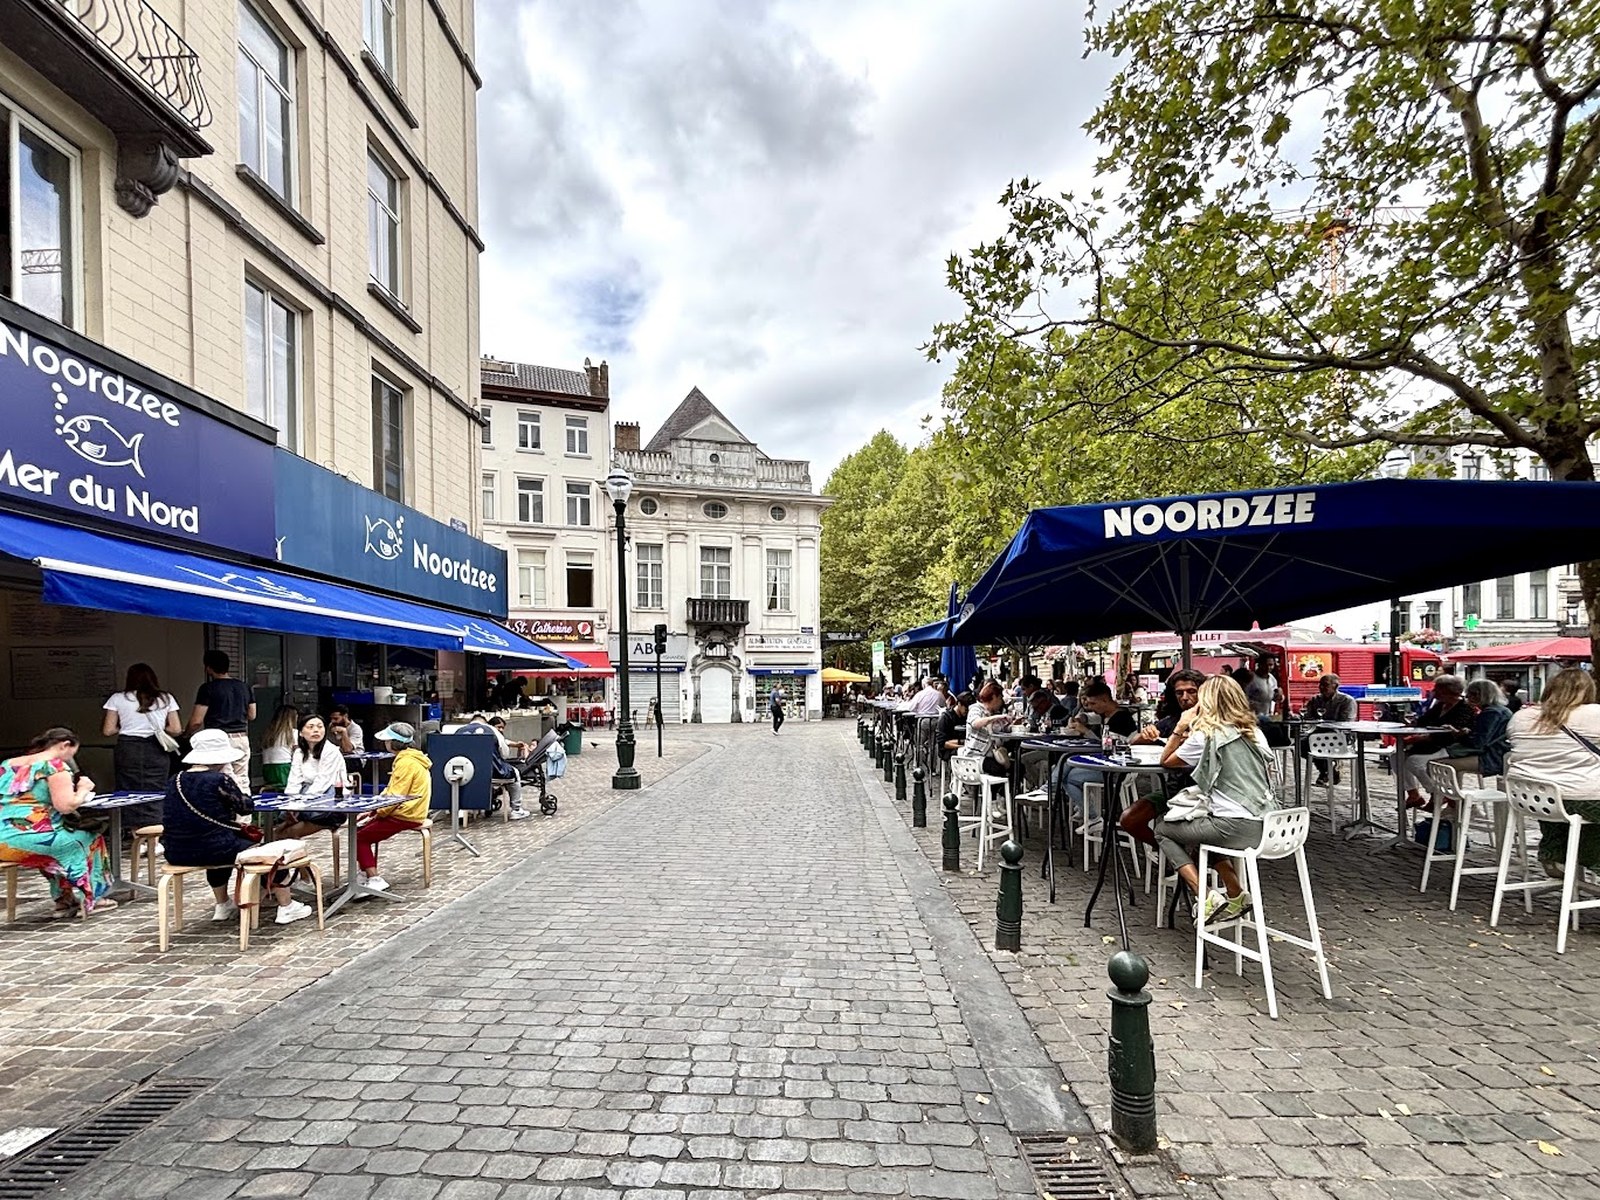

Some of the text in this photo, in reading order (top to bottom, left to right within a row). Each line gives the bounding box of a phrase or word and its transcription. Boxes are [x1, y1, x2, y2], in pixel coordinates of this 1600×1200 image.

[0, 321, 181, 427] Noordzee
[69, 475, 115, 512] du
[126, 485, 199, 533] Nord
[1104, 492, 1316, 538] NOORDZEE
[413, 538, 497, 593] Noordzee
[514, 620, 529, 634] St.
[530, 620, 573, 635] Catherine
